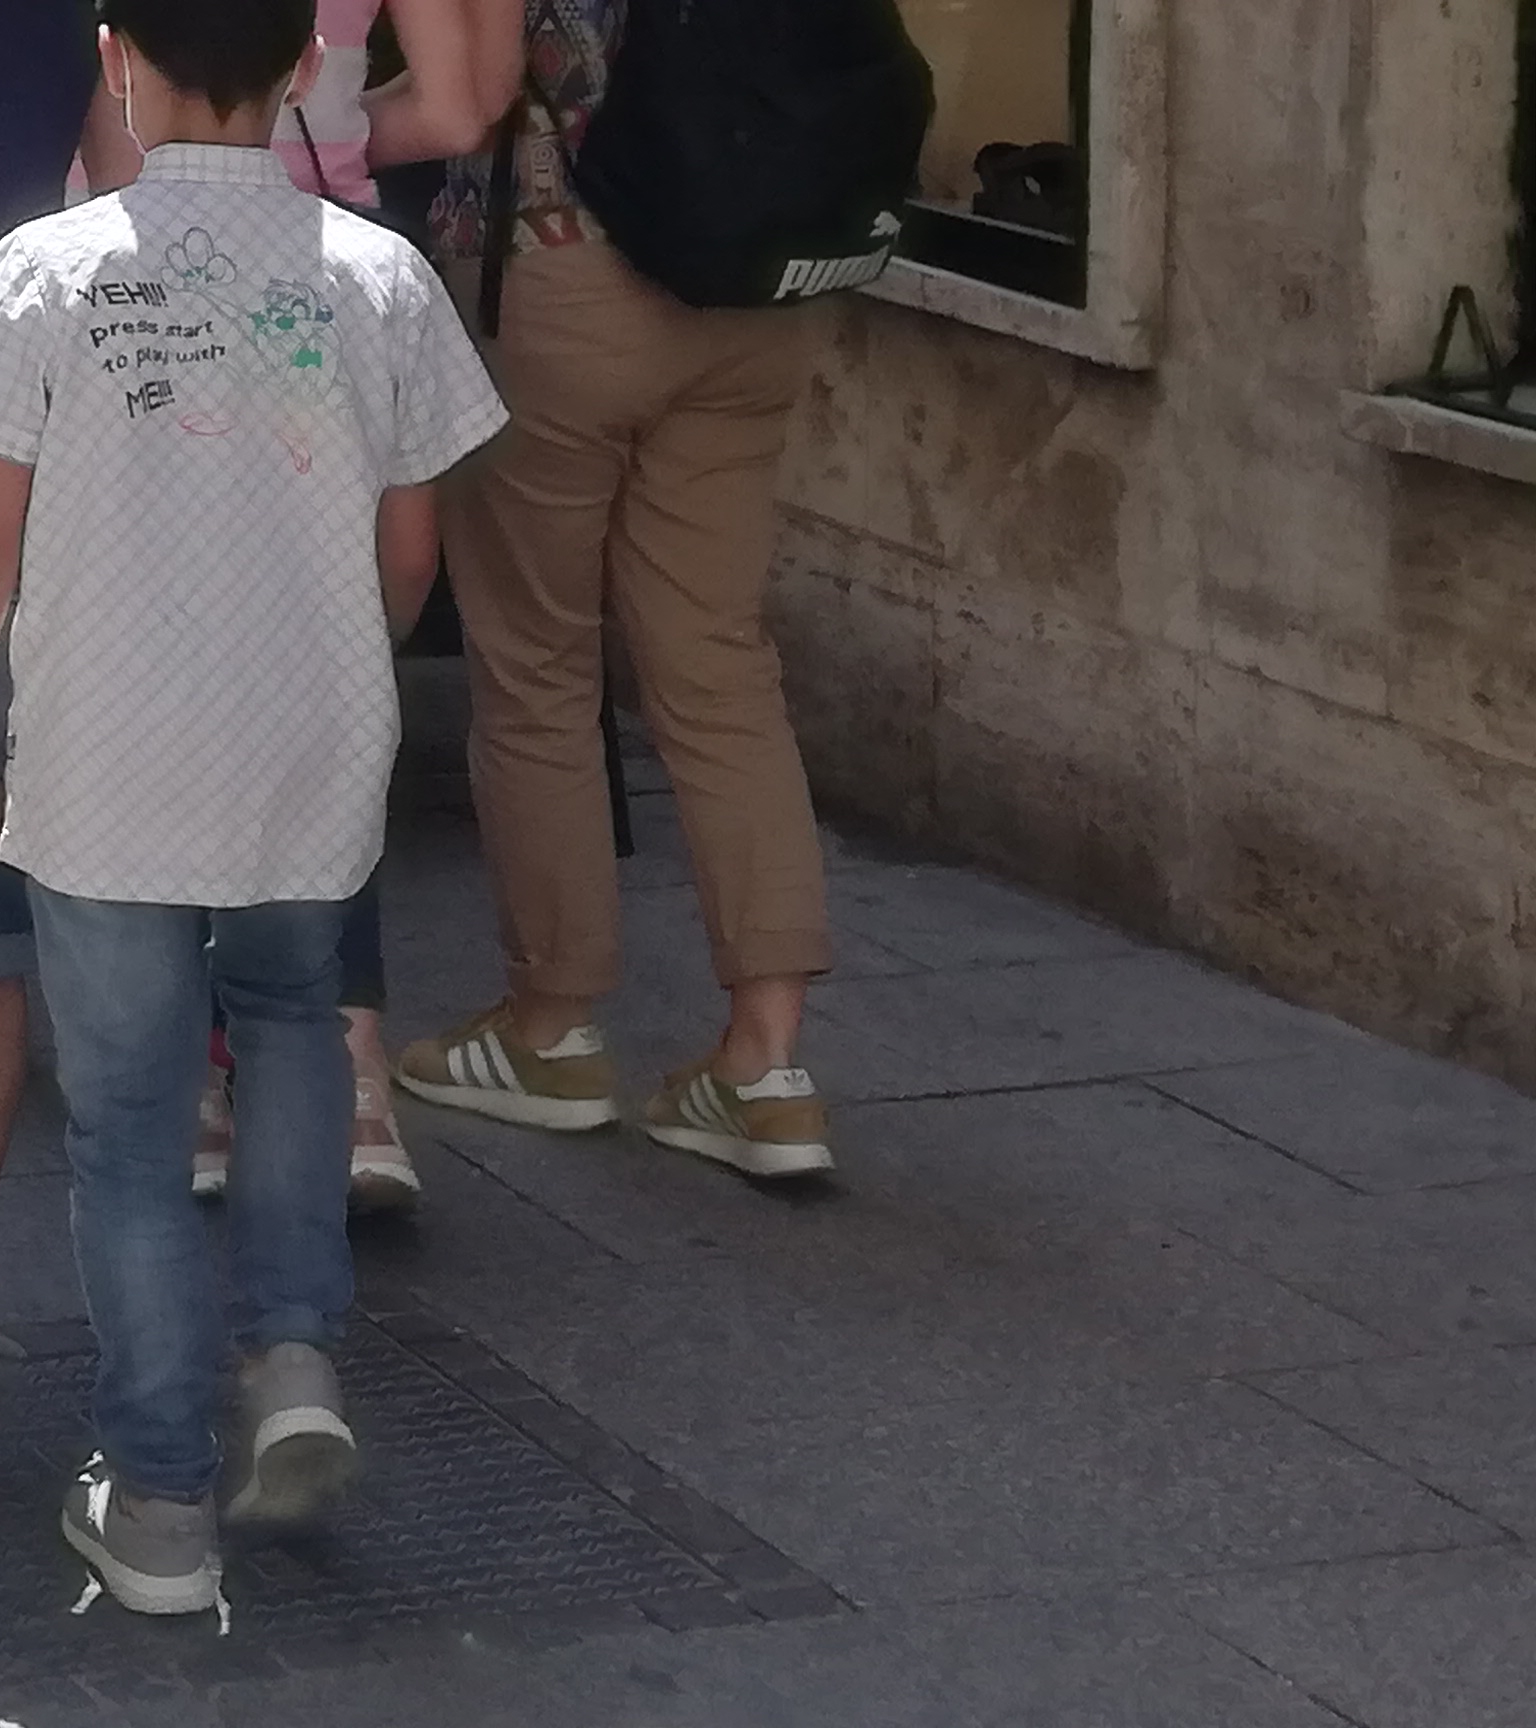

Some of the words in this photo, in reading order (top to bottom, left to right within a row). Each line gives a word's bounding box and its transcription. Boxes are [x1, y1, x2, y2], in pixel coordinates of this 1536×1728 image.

[89, 320, 159, 349] press
[165, 320, 214, 339] start
[102, 354, 128, 374] to
[135, 346, 170, 368] play
[175, 343, 227, 363] with
